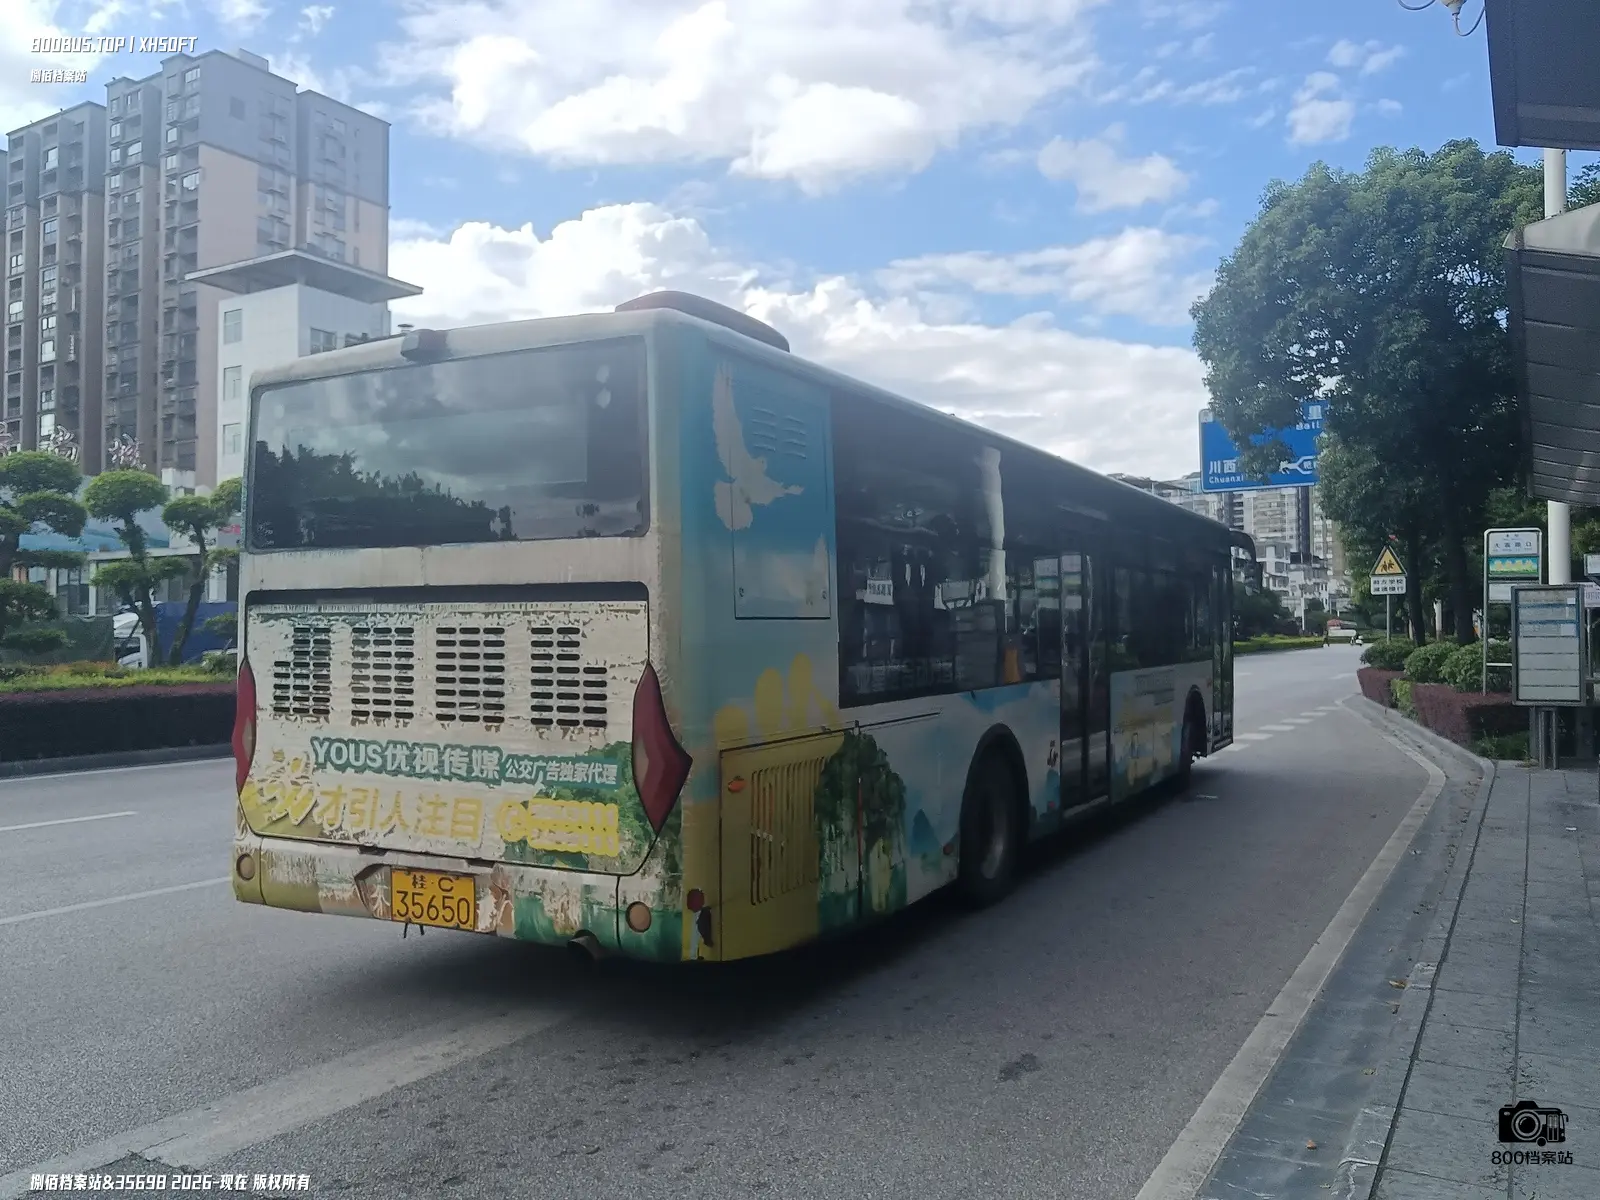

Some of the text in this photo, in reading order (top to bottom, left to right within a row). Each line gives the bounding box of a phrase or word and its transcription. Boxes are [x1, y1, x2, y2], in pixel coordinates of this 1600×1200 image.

[1208, 459, 1237, 475] 川西
[1208, 473, 1245, 484] Chuanxi
[505, 757, 618, 786] 公交广告独家代理
[395, 890, 471, 928] 35650
